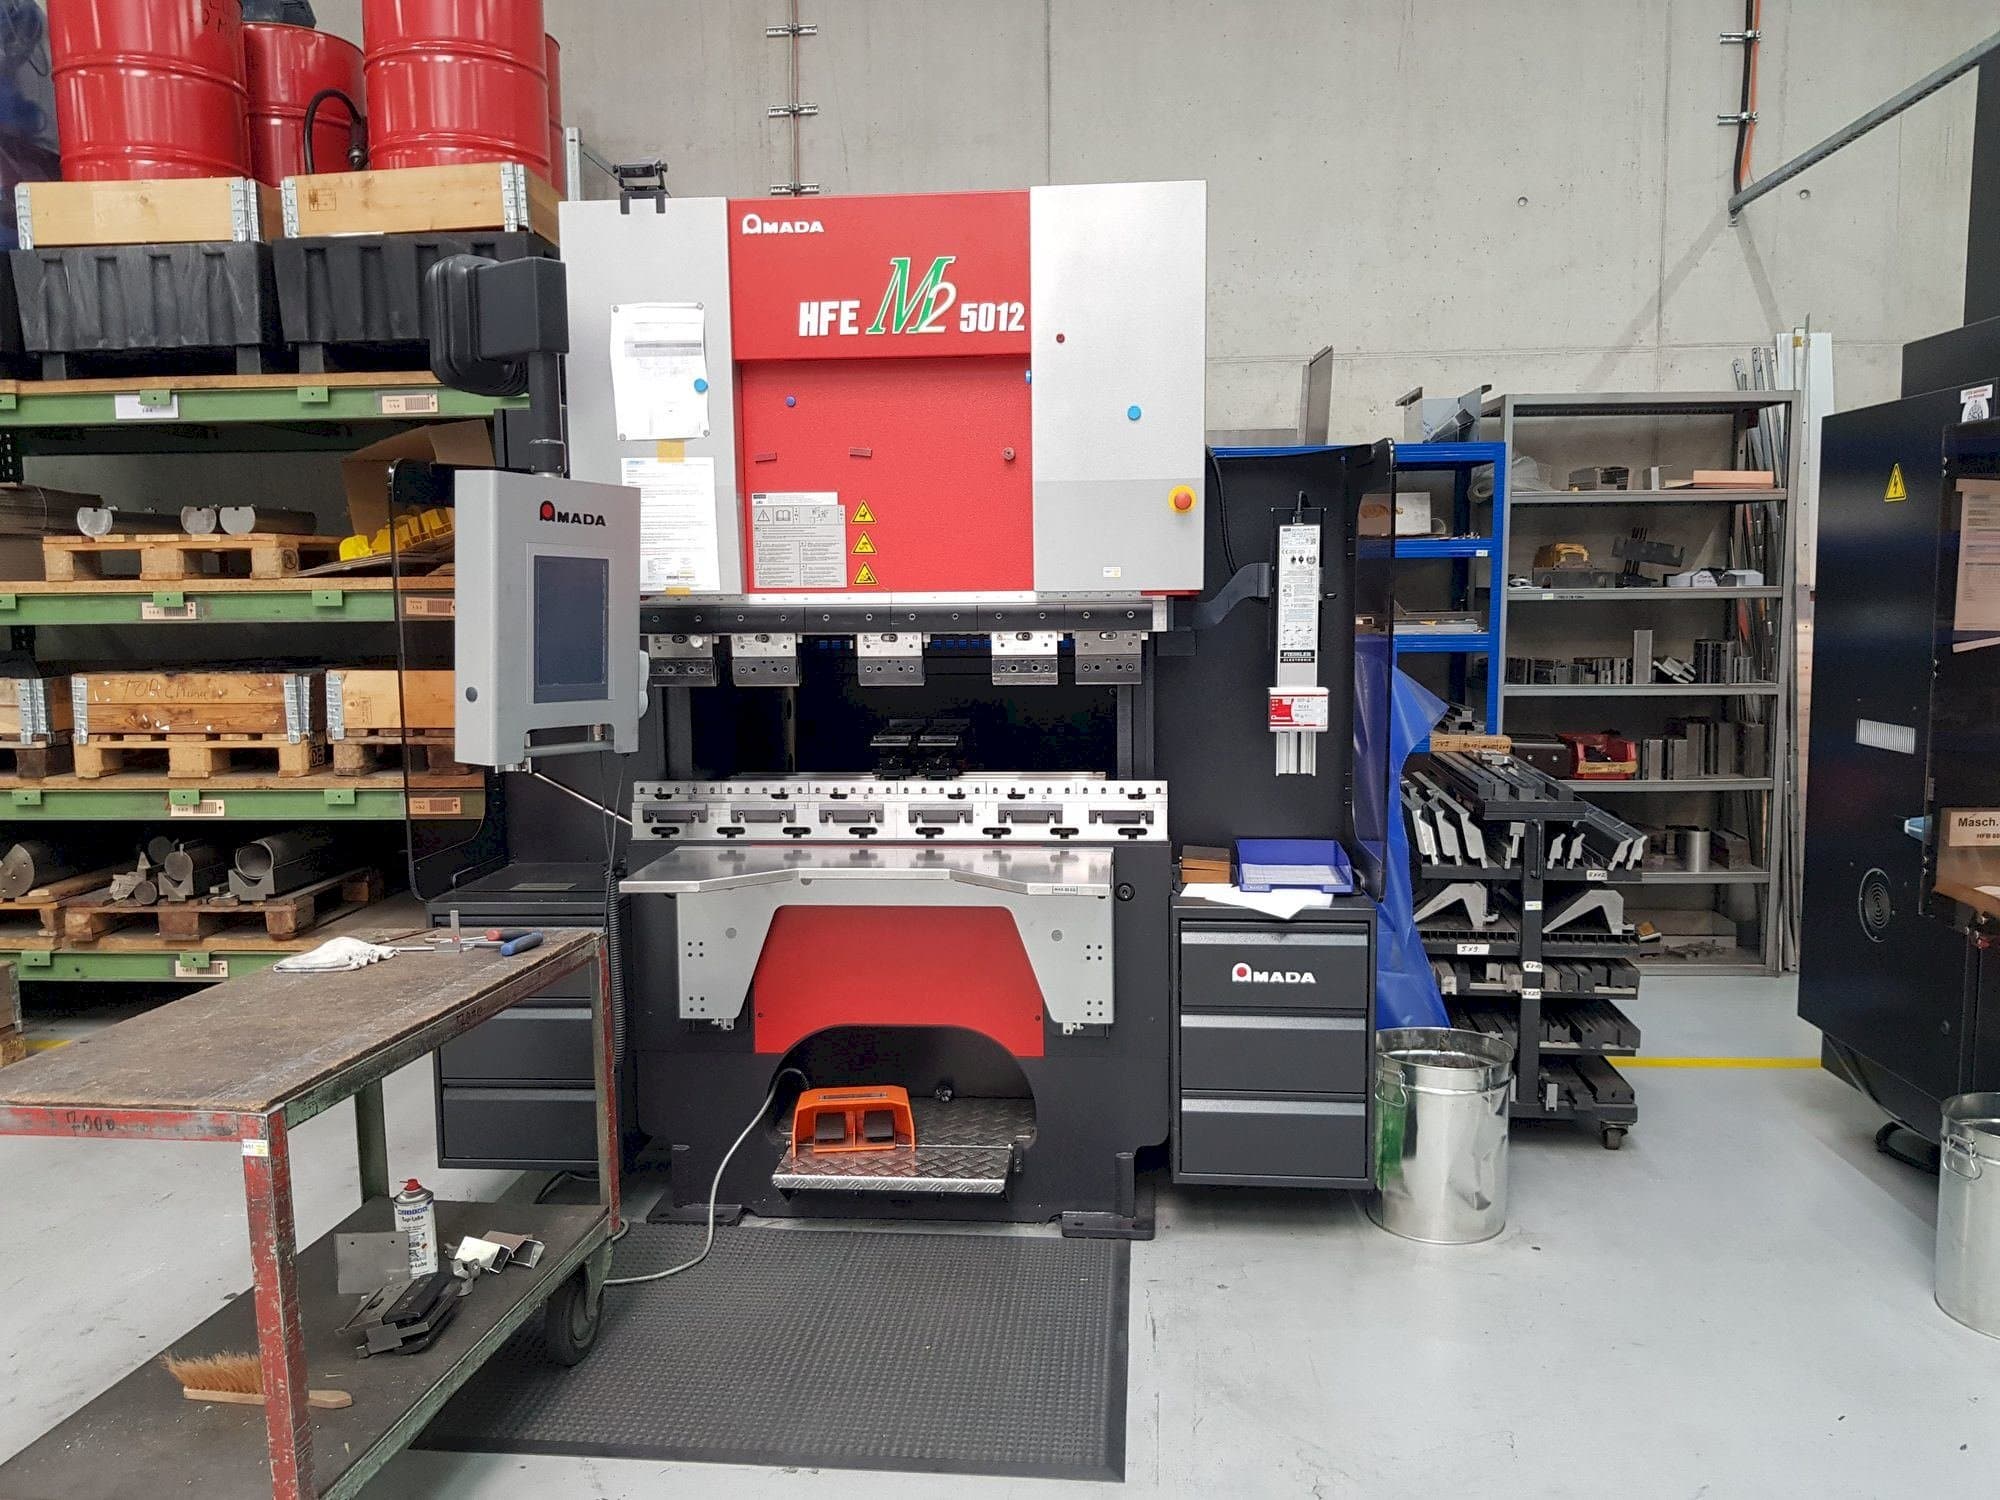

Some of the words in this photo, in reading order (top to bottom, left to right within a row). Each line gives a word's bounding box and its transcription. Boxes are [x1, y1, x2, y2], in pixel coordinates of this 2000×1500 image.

[742, 213, 825, 235] AMADA
[799, 300, 860, 336] HFE
[959, 302, 1026, 332] 5012
[539, 500, 606, 527] AMADA
[1958, 817, 1999, 827] Masch.
[1231, 962, 1317, 984] AMADA
